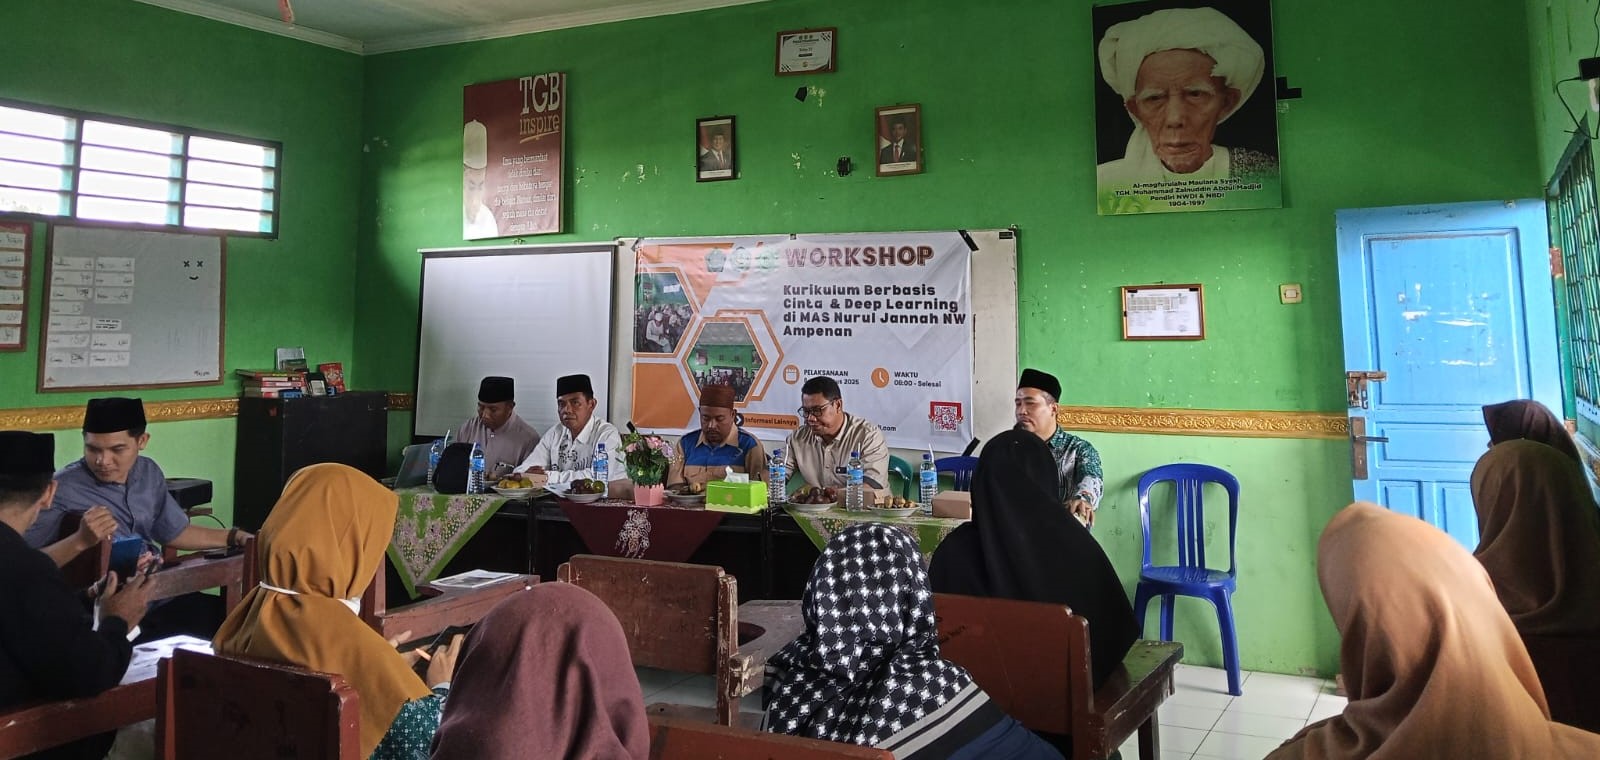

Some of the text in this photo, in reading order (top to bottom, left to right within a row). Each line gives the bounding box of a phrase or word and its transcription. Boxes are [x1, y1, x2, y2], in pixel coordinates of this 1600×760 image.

[520, 72, 560, 114] TGB
[520, 114, 560, 140] inspire
[1236, 183, 1262, 191] Madjid
[785, 245, 934, 267] WORKSHOP
[783, 284, 936, 296] Kurikulum Berbasis
[783, 298, 958, 313] Cinta & Deep Learning
[783, 311, 966, 324] di MAS Nurul Jannah NW
[783, 326, 852, 338] Ampenan
[804, 369, 848, 377] PELAKSANAAN
